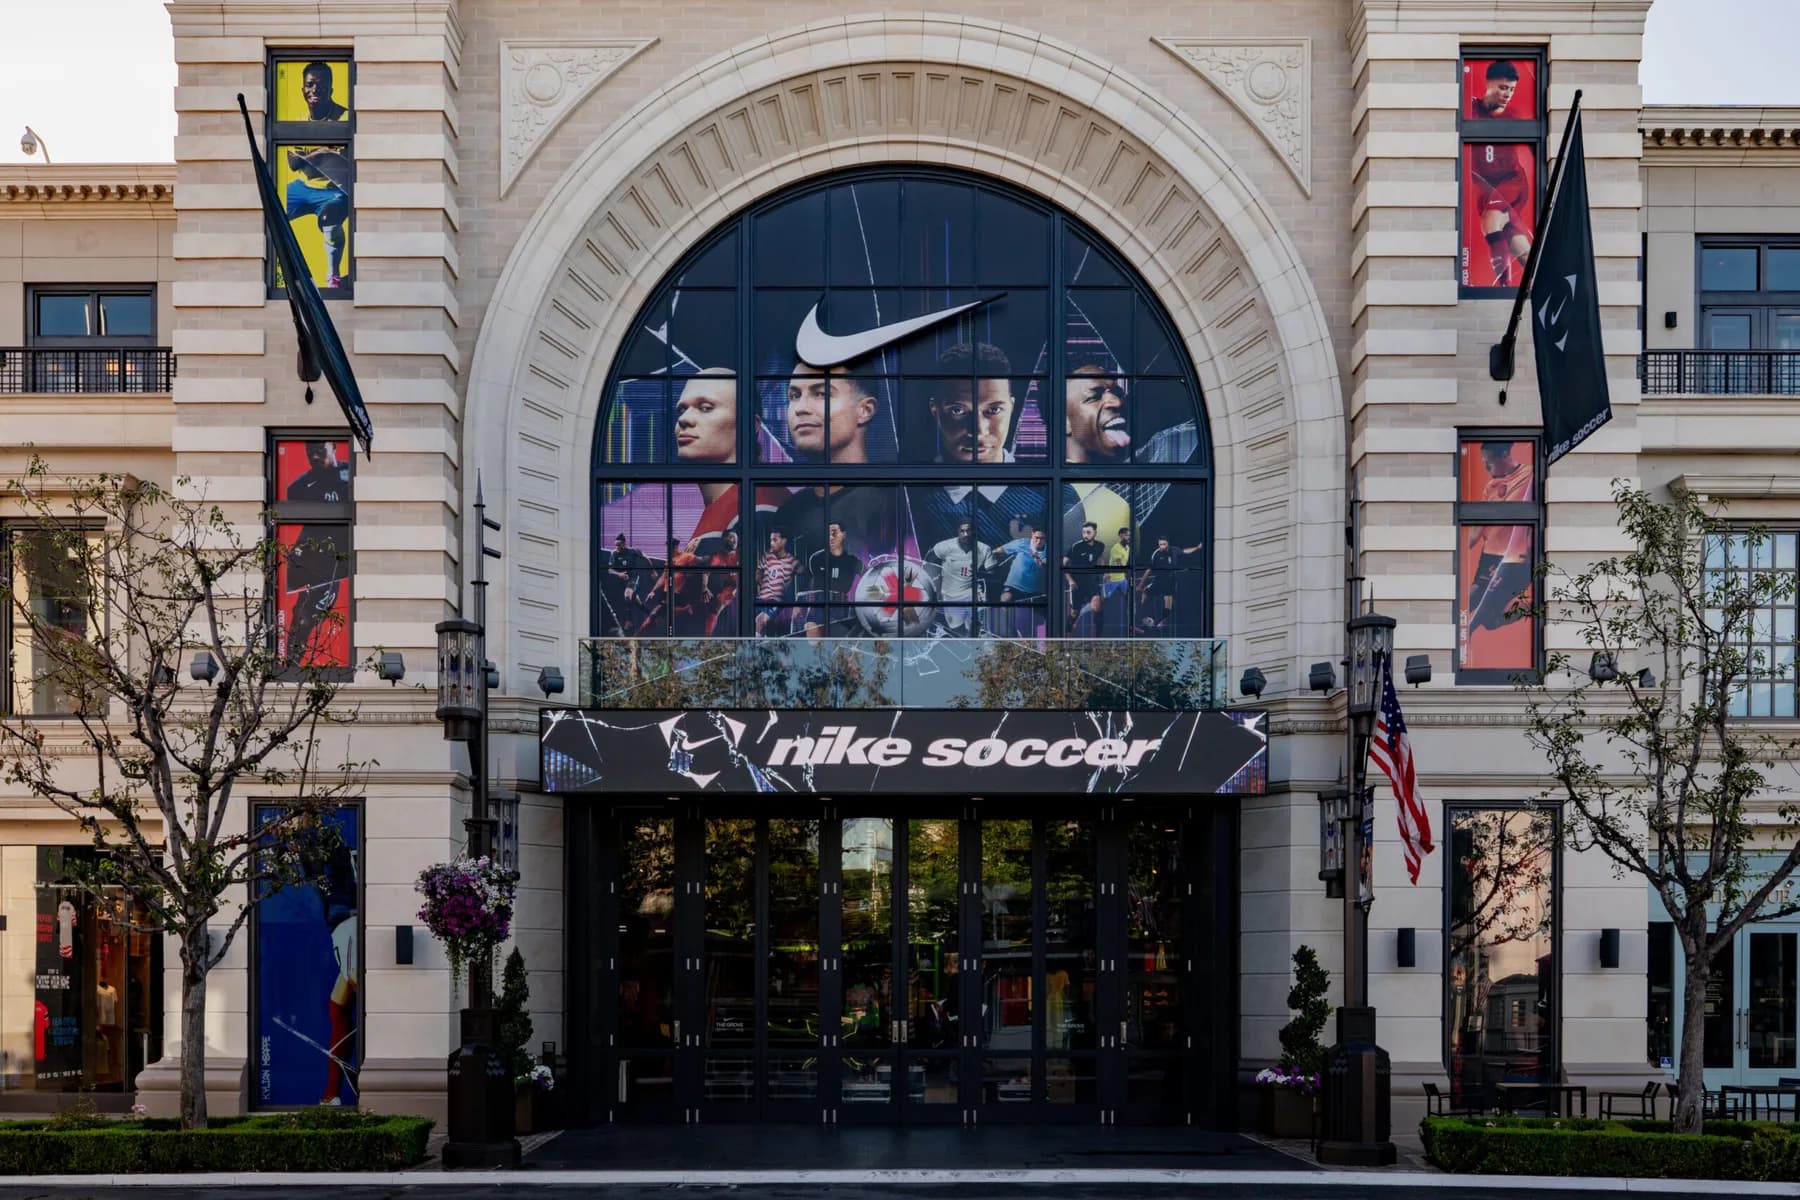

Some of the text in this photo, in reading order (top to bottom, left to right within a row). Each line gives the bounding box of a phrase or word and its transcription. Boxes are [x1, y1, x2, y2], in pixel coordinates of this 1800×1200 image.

[1485, 146, 1494, 163] 8
[1572, 407, 1609, 446] soccer
[767, 726, 1163, 767] nike soccer
[261, 1069, 271, 1100] KYLIAN
